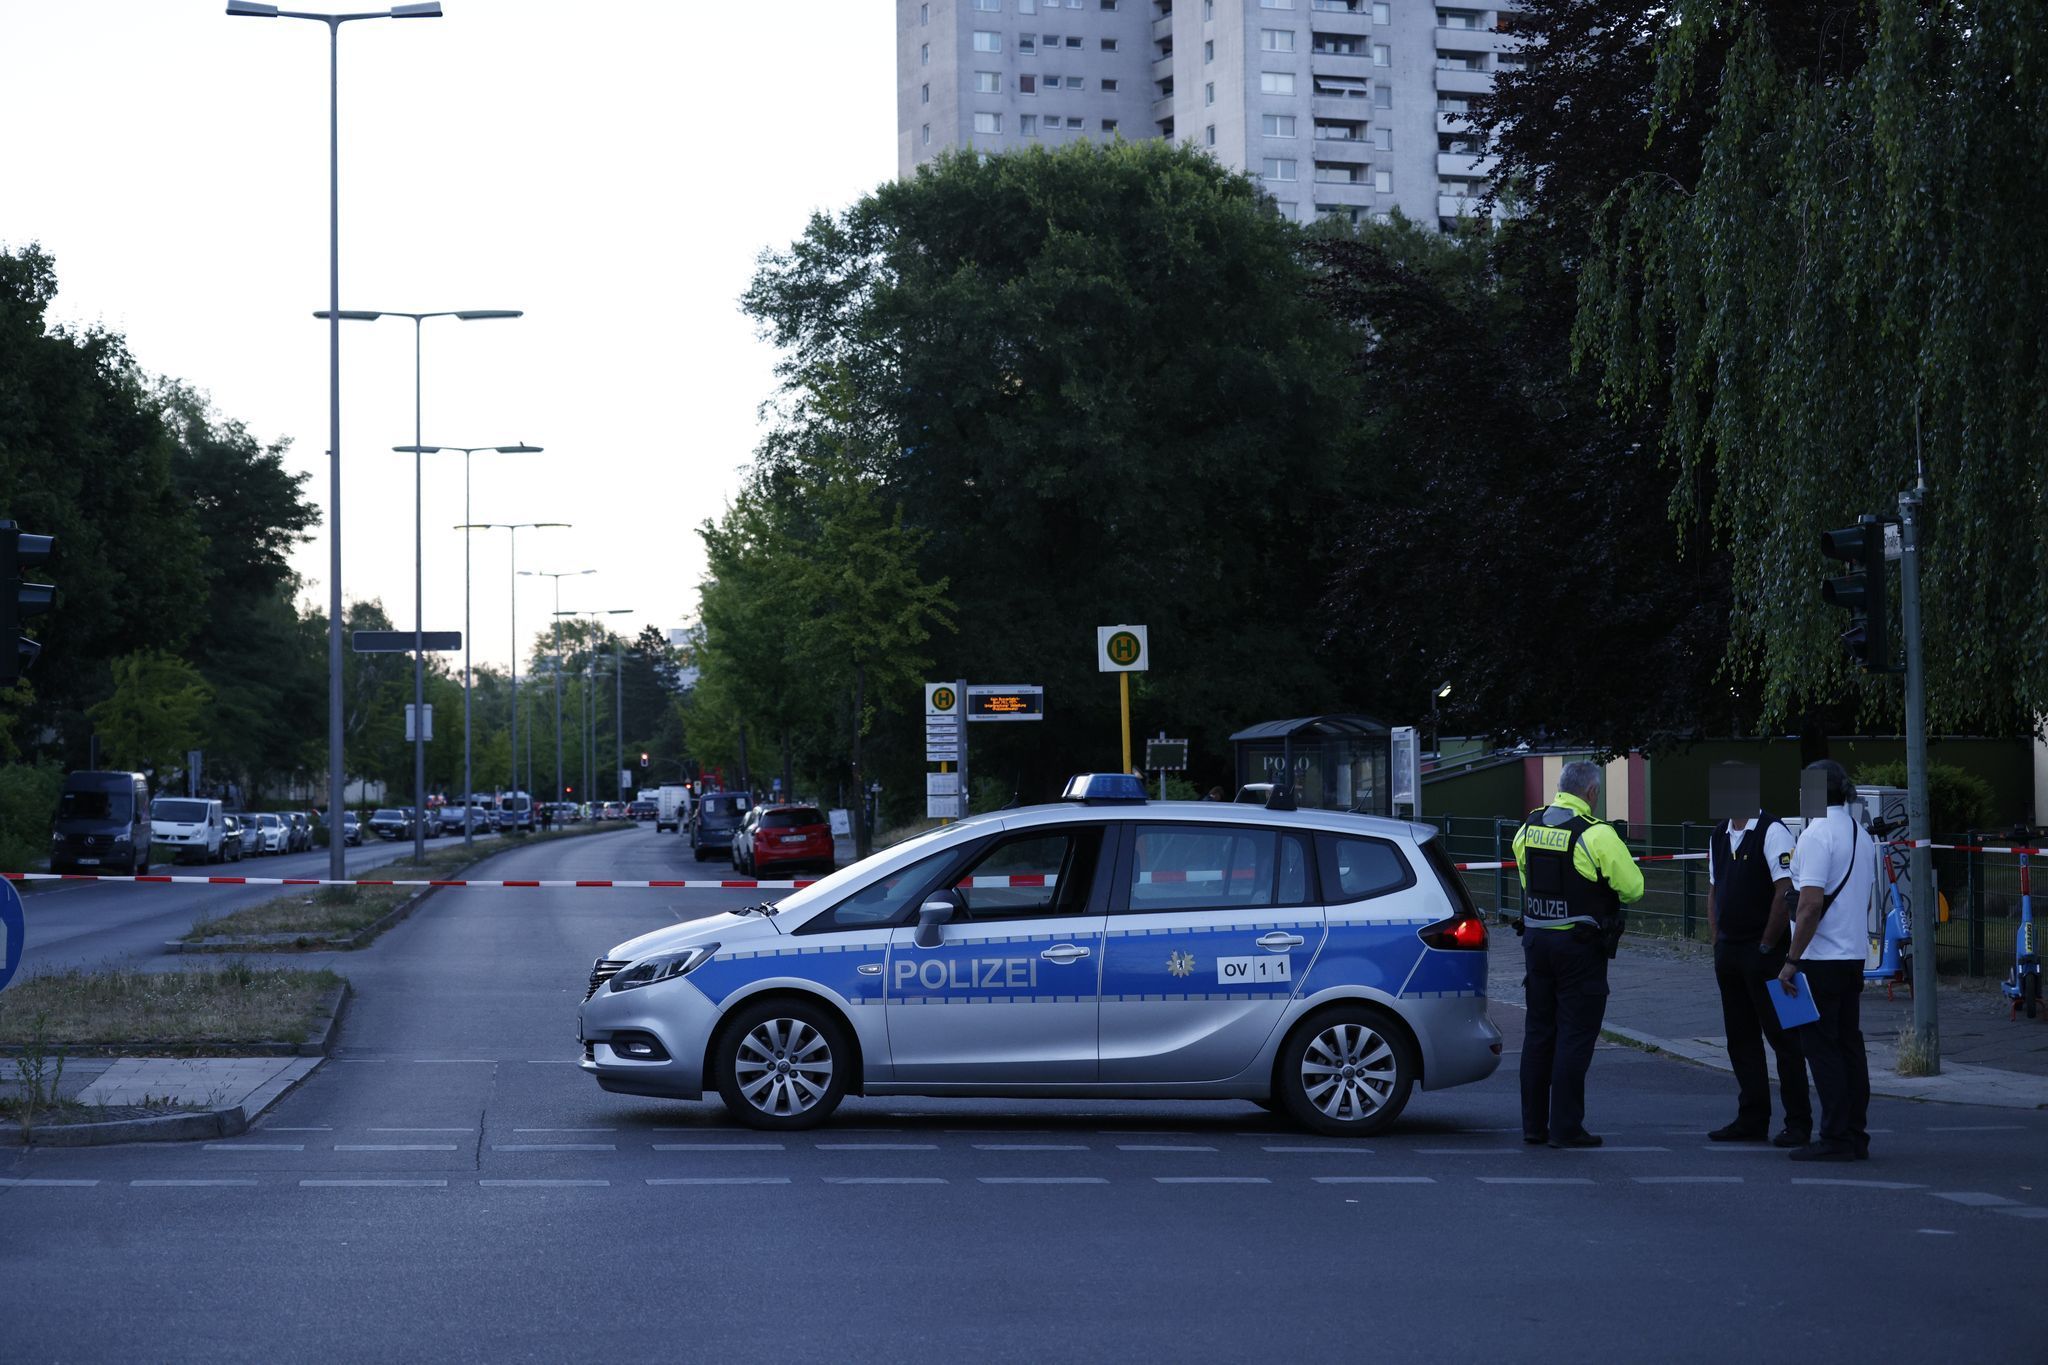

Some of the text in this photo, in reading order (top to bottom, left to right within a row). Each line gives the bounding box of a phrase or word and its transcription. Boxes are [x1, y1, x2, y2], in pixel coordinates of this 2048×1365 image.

[1264, 756, 1309, 770] POO
[1528, 828, 1568, 849] POLIZEI
[1528, 896, 1568, 918] POLIZEI
[895, 958, 1036, 989] POLIZEI
[1224, 963, 1247, 977] OV
